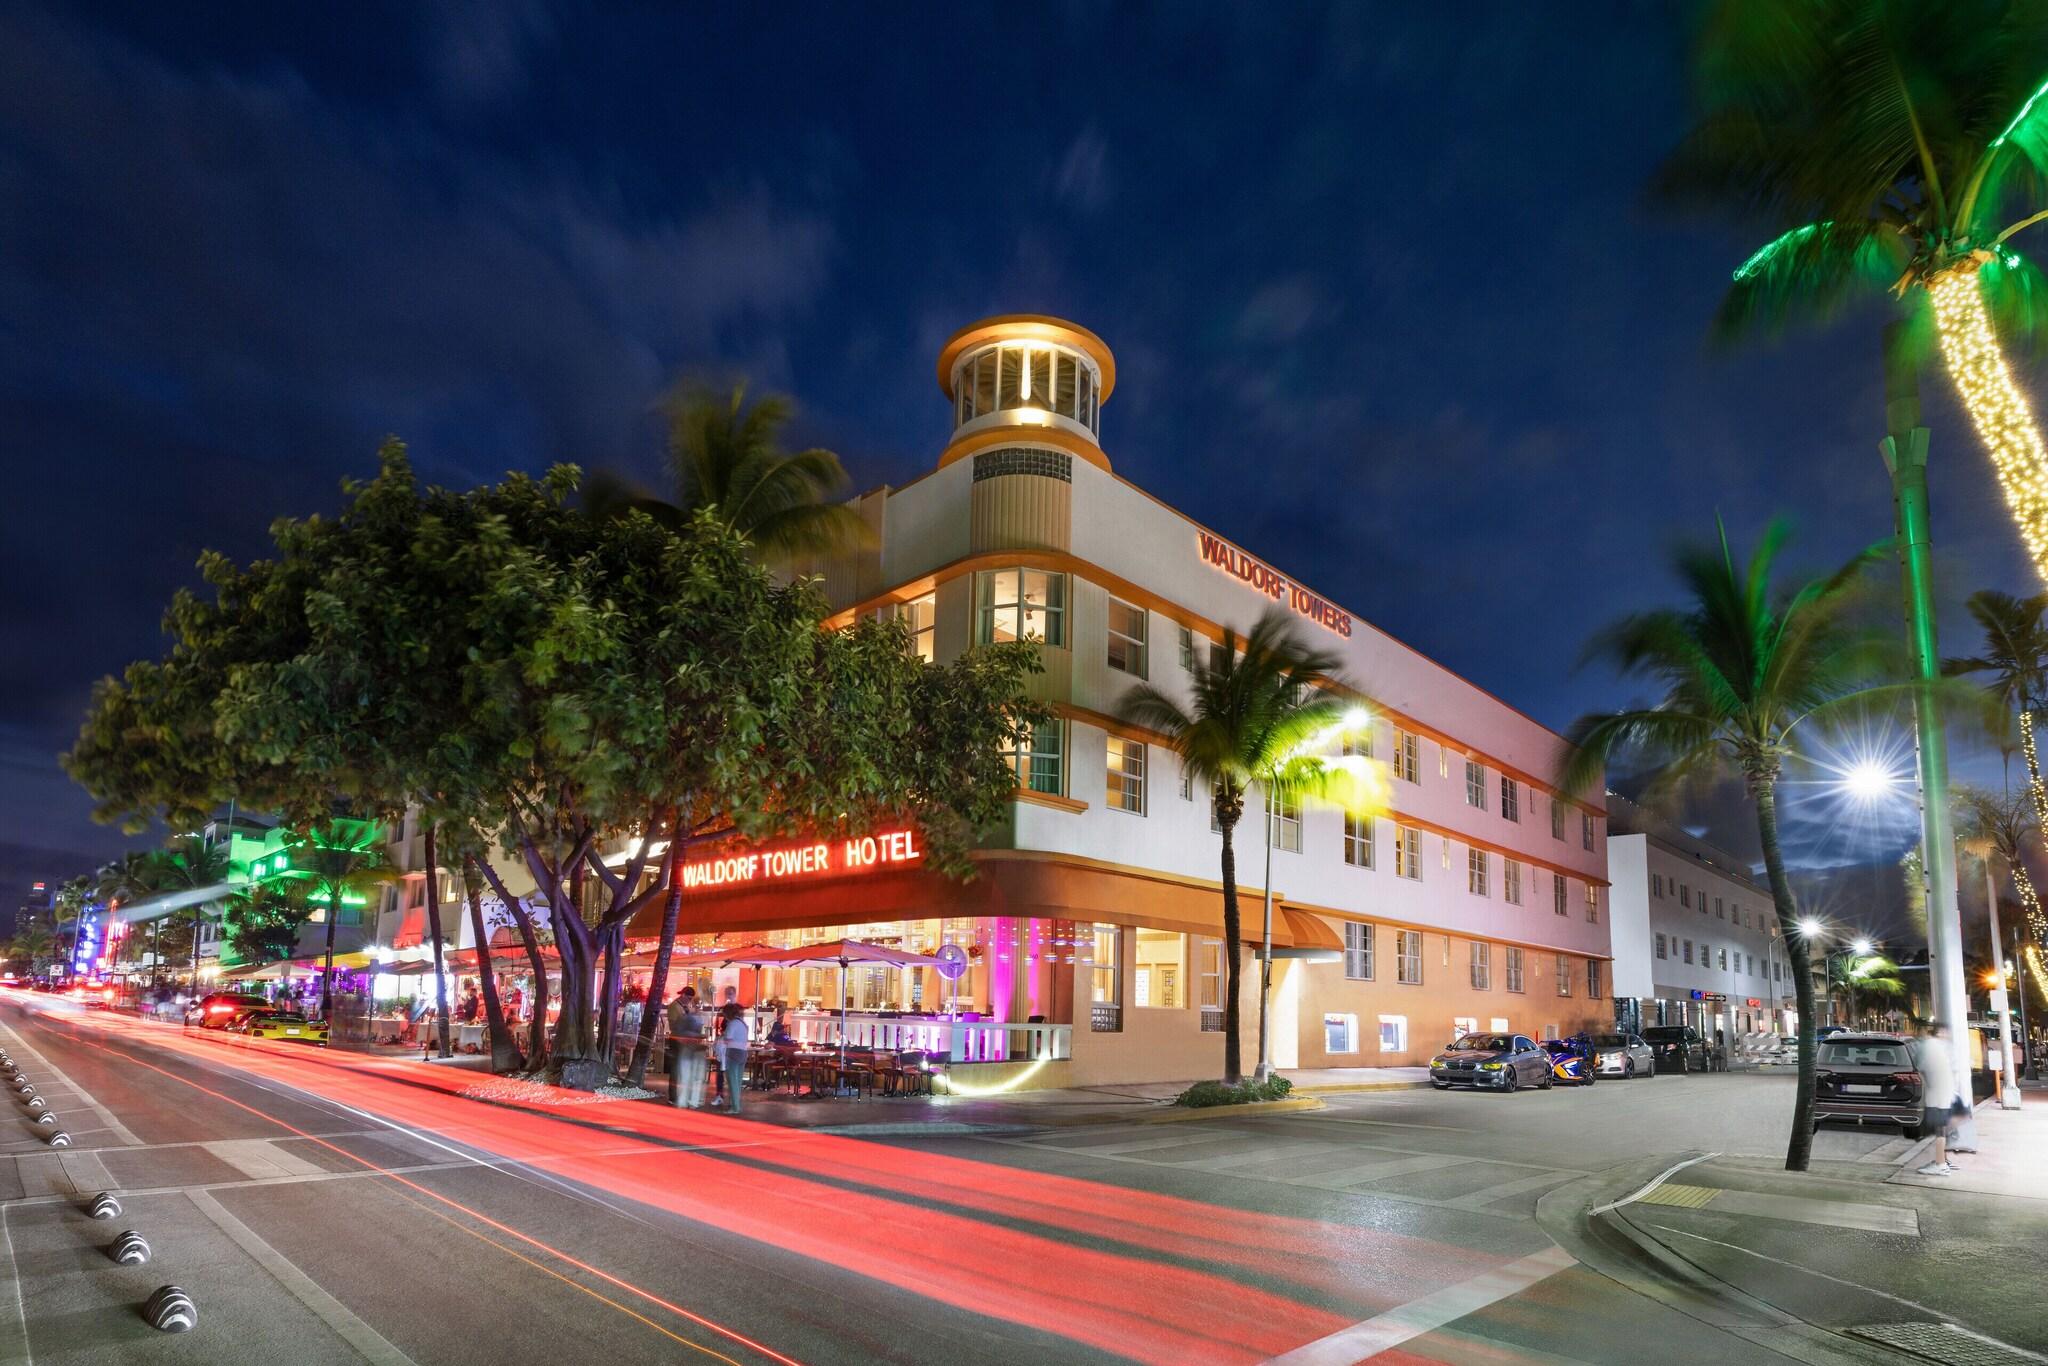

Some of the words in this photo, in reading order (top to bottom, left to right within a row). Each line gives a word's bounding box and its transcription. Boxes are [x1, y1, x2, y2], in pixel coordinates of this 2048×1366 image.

[1199, 531, 1286, 600] WALDORF
[1287, 583, 1352, 637] TOWERS
[683, 855, 758, 887] WALDORF
[762, 845, 828, 877] TOWER
[846, 831, 920, 867] HOTEL
